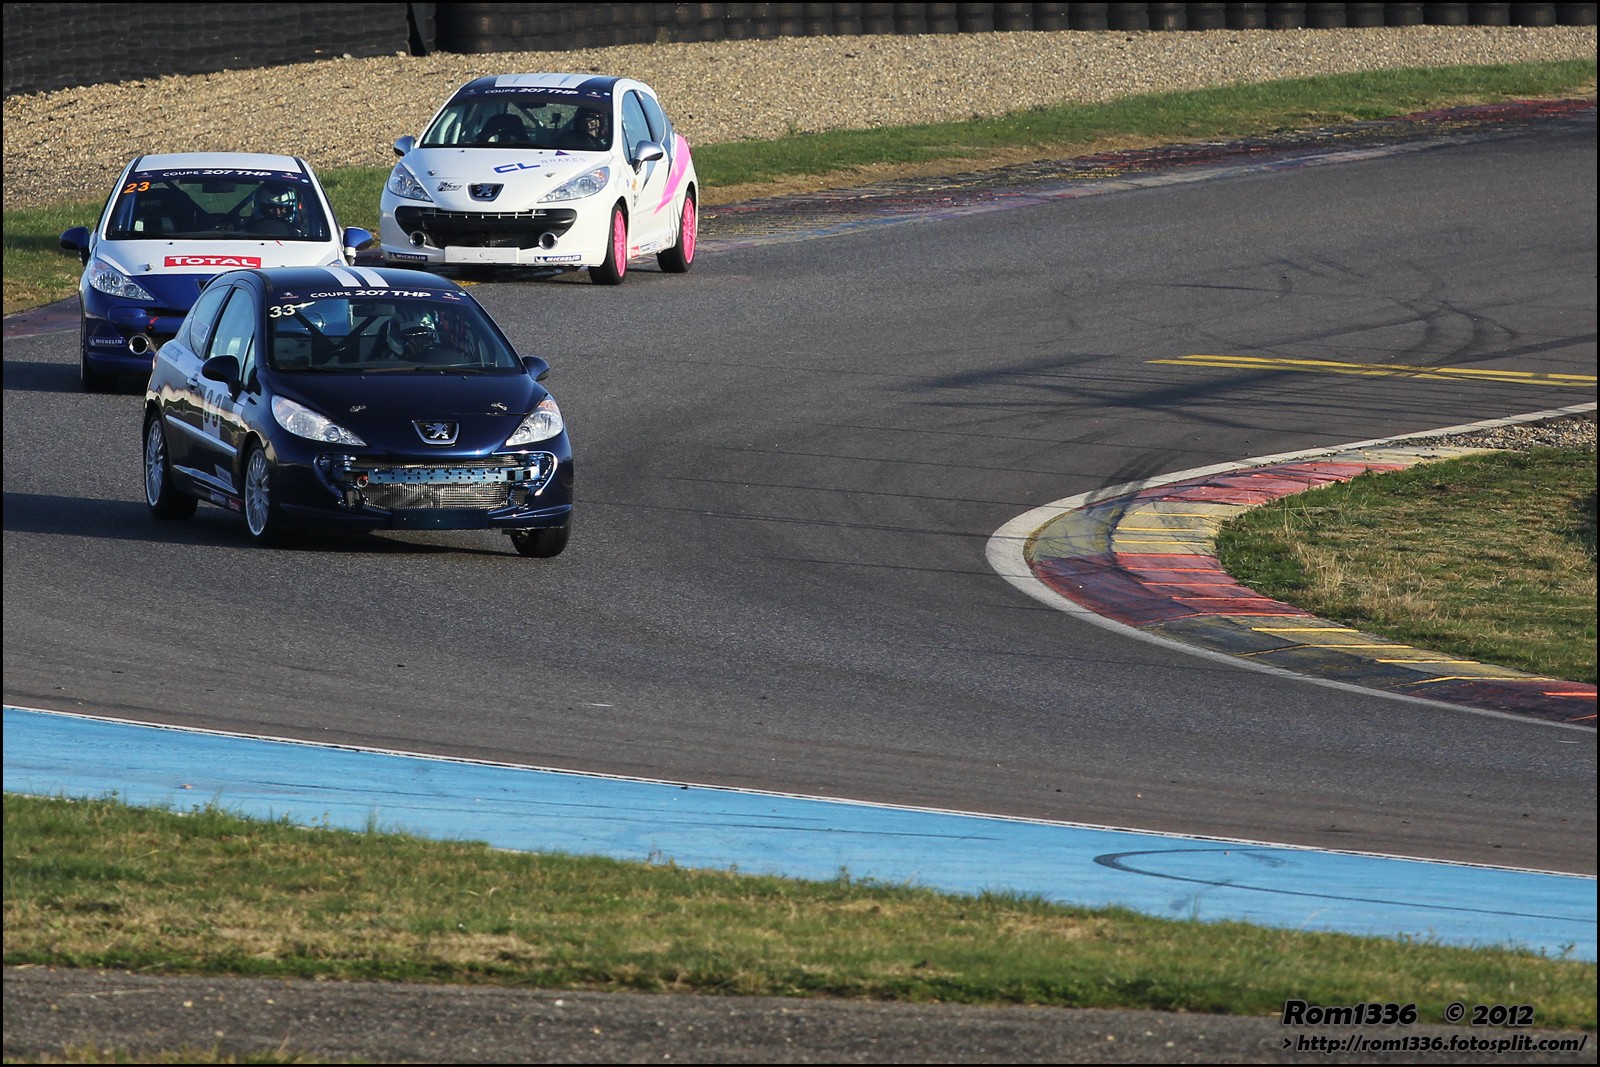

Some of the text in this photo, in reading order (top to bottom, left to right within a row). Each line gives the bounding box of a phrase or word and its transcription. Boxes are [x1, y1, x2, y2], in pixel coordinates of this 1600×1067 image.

[235, 169, 272, 177] THP
[493, 162, 541, 174] CL
[123, 181, 150, 194] 23
[168, 256, 258, 267] TOTAL
[546, 254, 581, 263] MICHELIN
[391, 290, 432, 298] THP
[269, 304, 296, 318] 33
